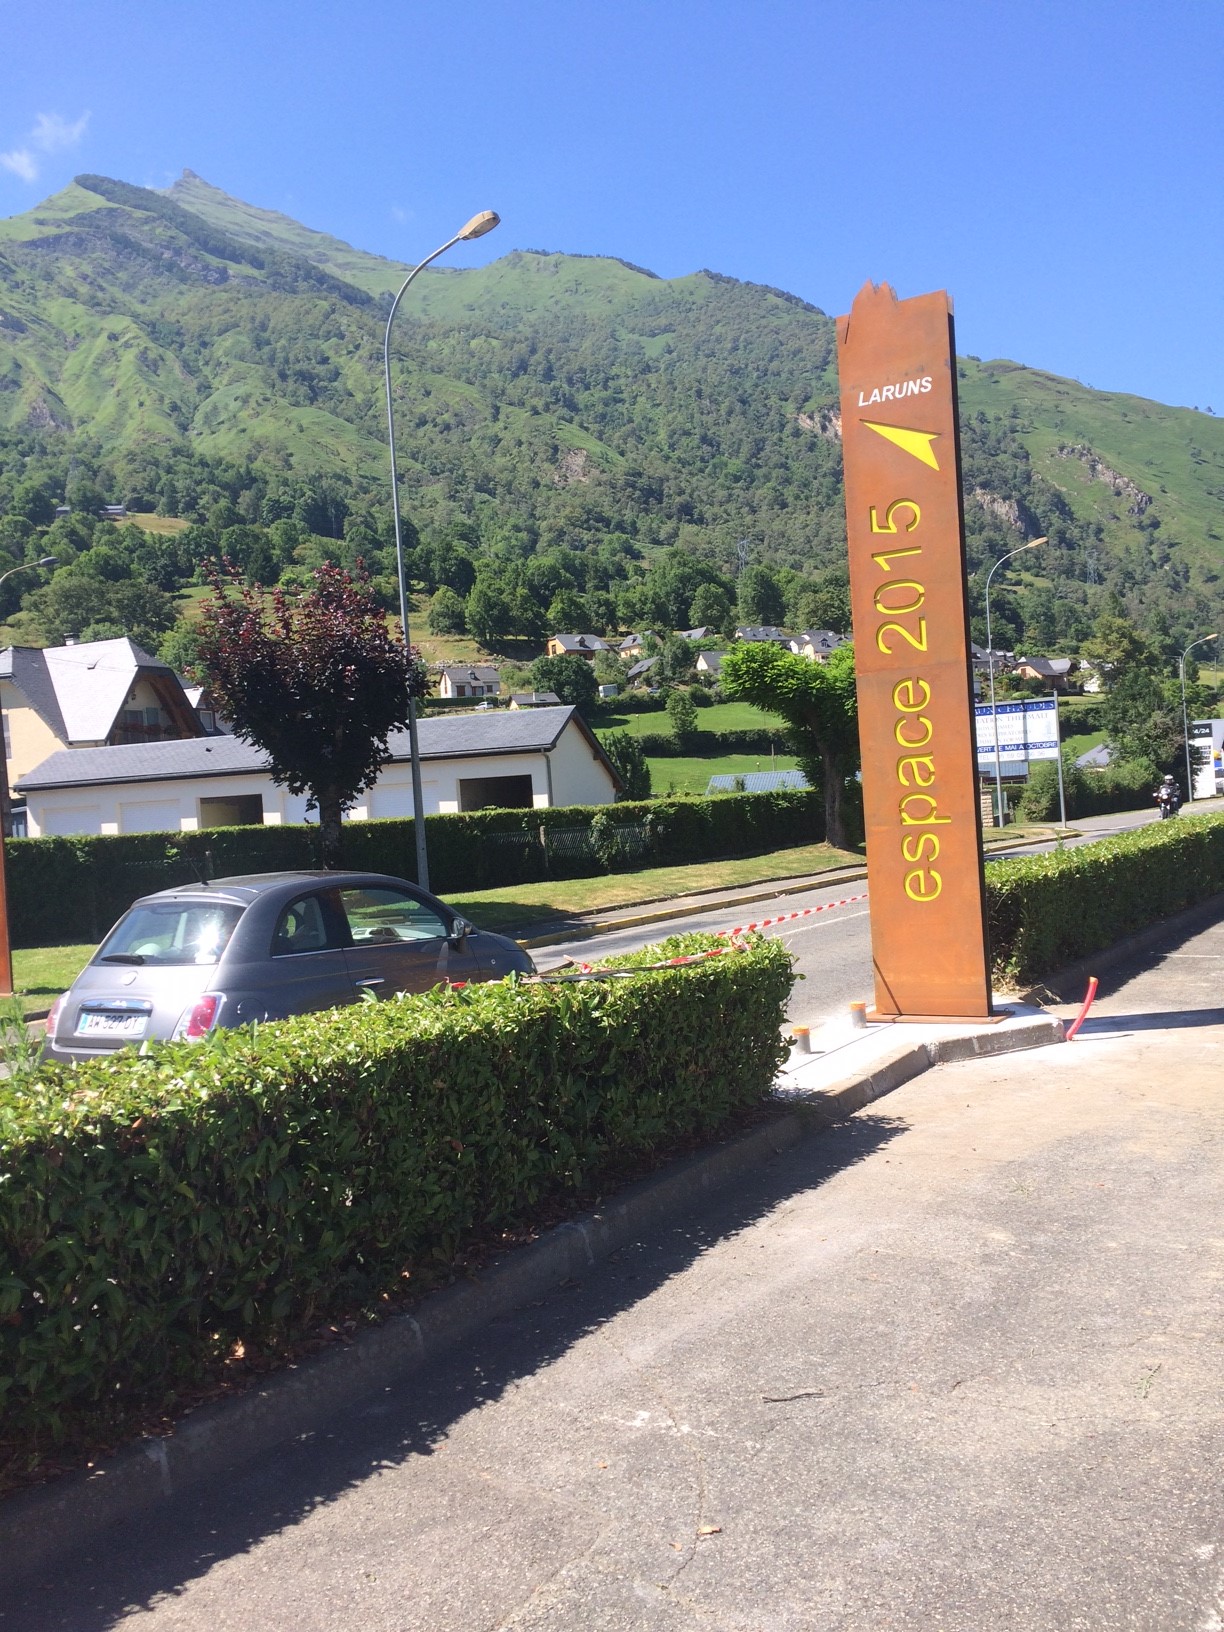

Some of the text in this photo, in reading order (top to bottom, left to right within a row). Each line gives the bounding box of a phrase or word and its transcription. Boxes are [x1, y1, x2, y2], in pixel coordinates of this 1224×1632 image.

[858, 376, 933, 407] LARUNS
[869, 498, 951, 902] espace 2015
[1026, 741, 1057, 749] OCTOBRE
